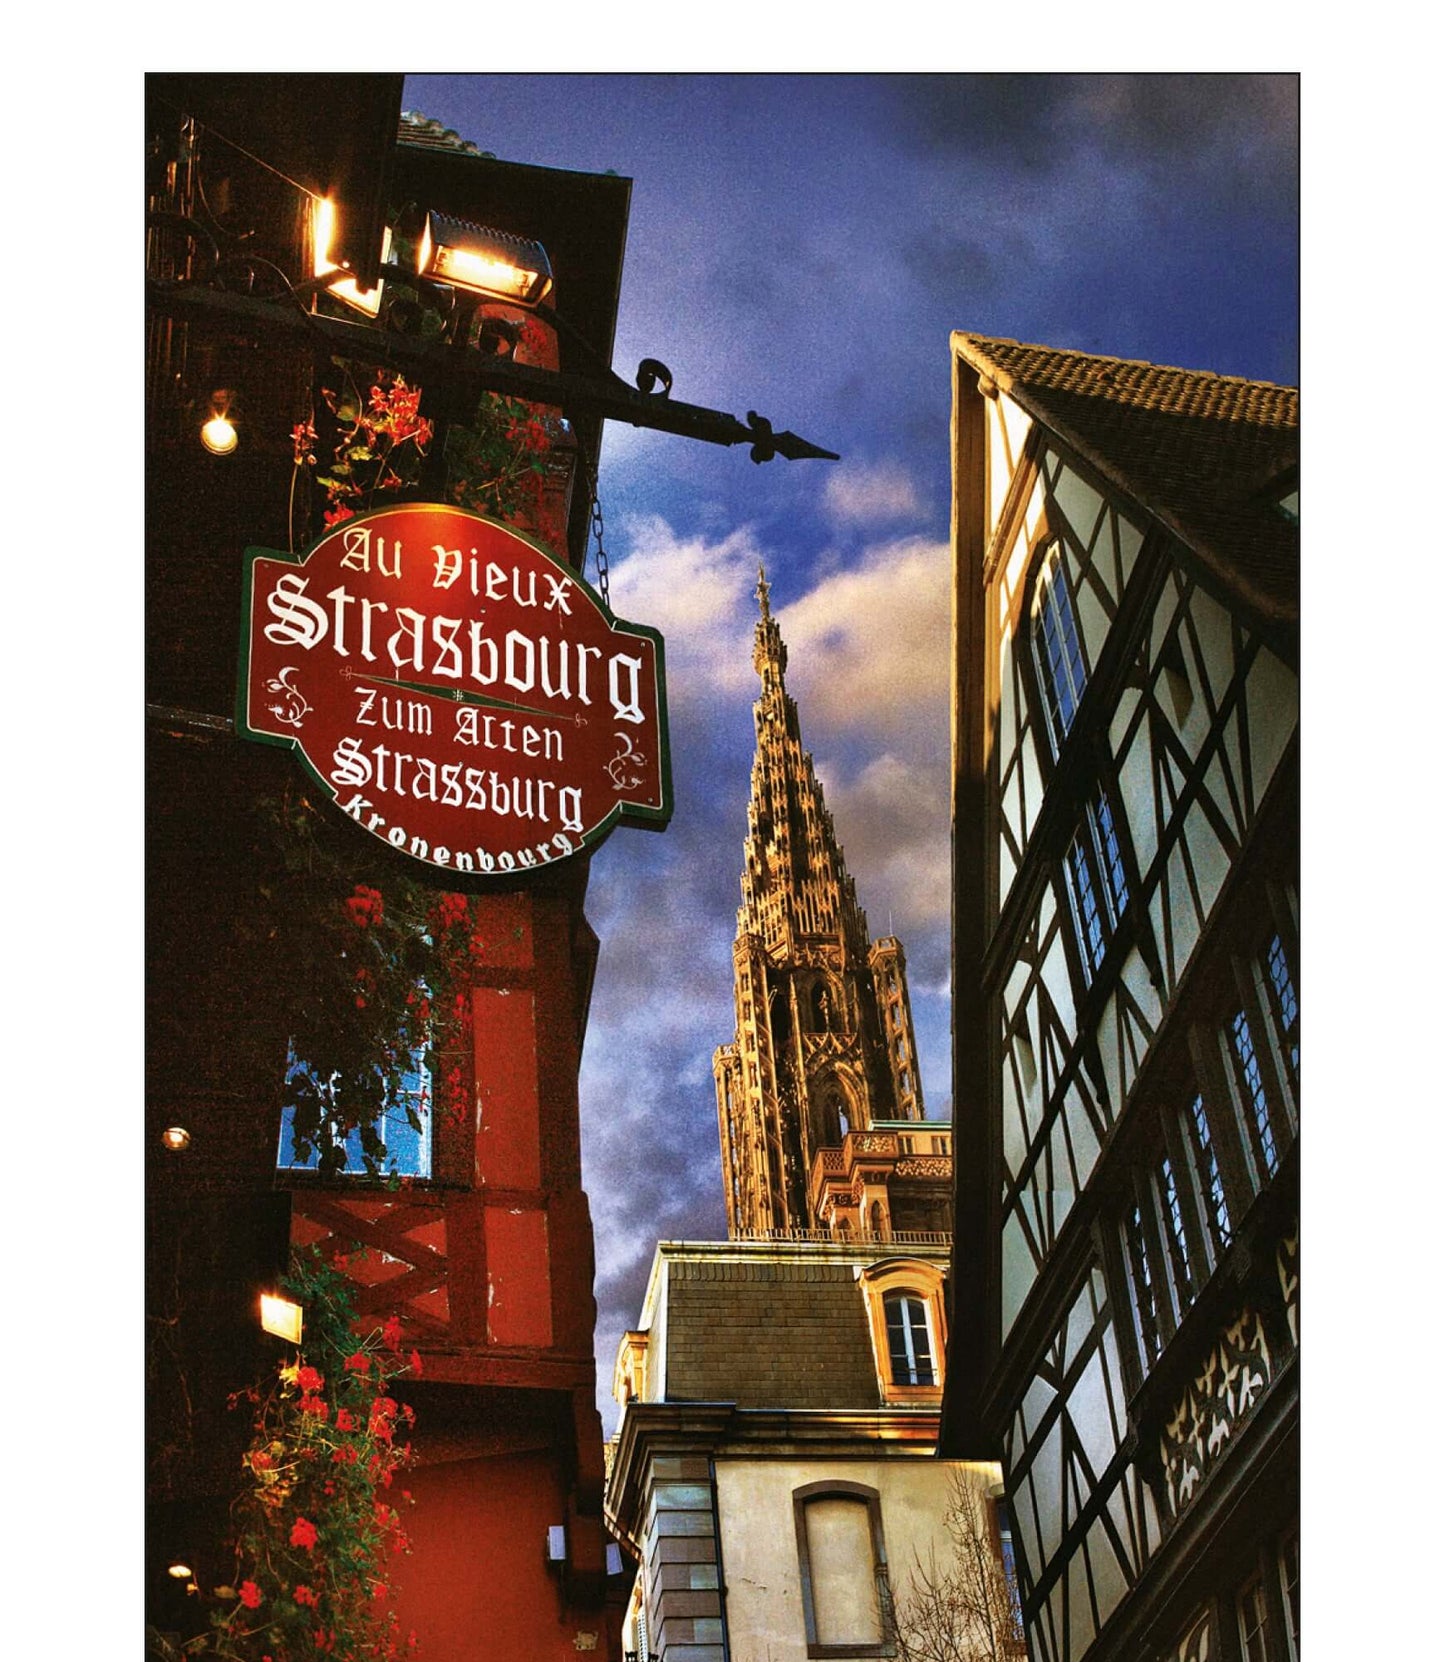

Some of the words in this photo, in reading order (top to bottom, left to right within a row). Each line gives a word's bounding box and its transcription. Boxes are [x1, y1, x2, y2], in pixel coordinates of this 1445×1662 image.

[340, 528, 402, 579] Au
[431, 544, 574, 616] Vieux
[263, 572, 646, 725] Strasbourg
[353, 686, 433, 737] Zum
[330, 736, 583, 832] Strassburg
[342, 793, 574, 872] Kronenbourg
